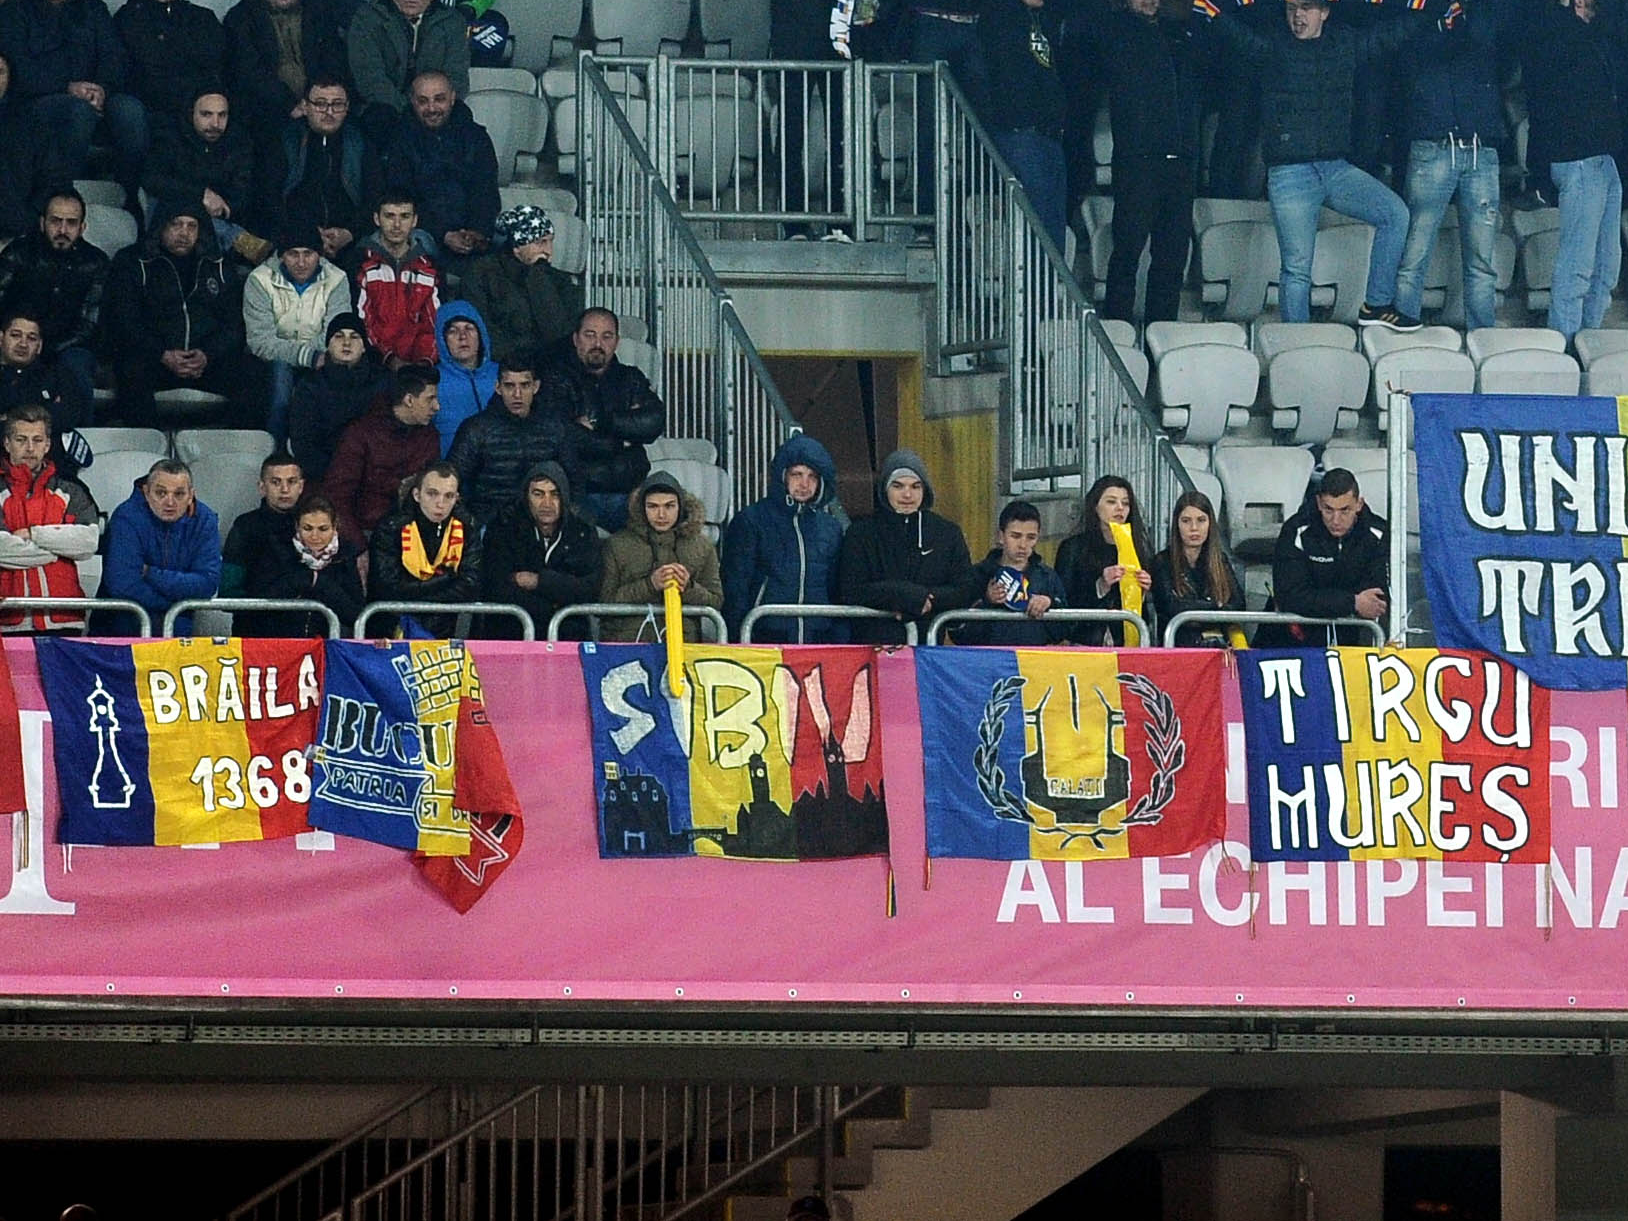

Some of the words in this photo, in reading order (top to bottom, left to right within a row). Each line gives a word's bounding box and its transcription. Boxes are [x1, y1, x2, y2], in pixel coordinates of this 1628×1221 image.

[149, 651, 321, 724] BRĂILA
[601, 657, 873, 769] SIBIU
[191, 750, 312, 812] 1368
[330, 768, 407, 805] PATRIA
[996, 856, 1115, 923] AL
[1143, 841, 1504, 928] ECHIPEI
